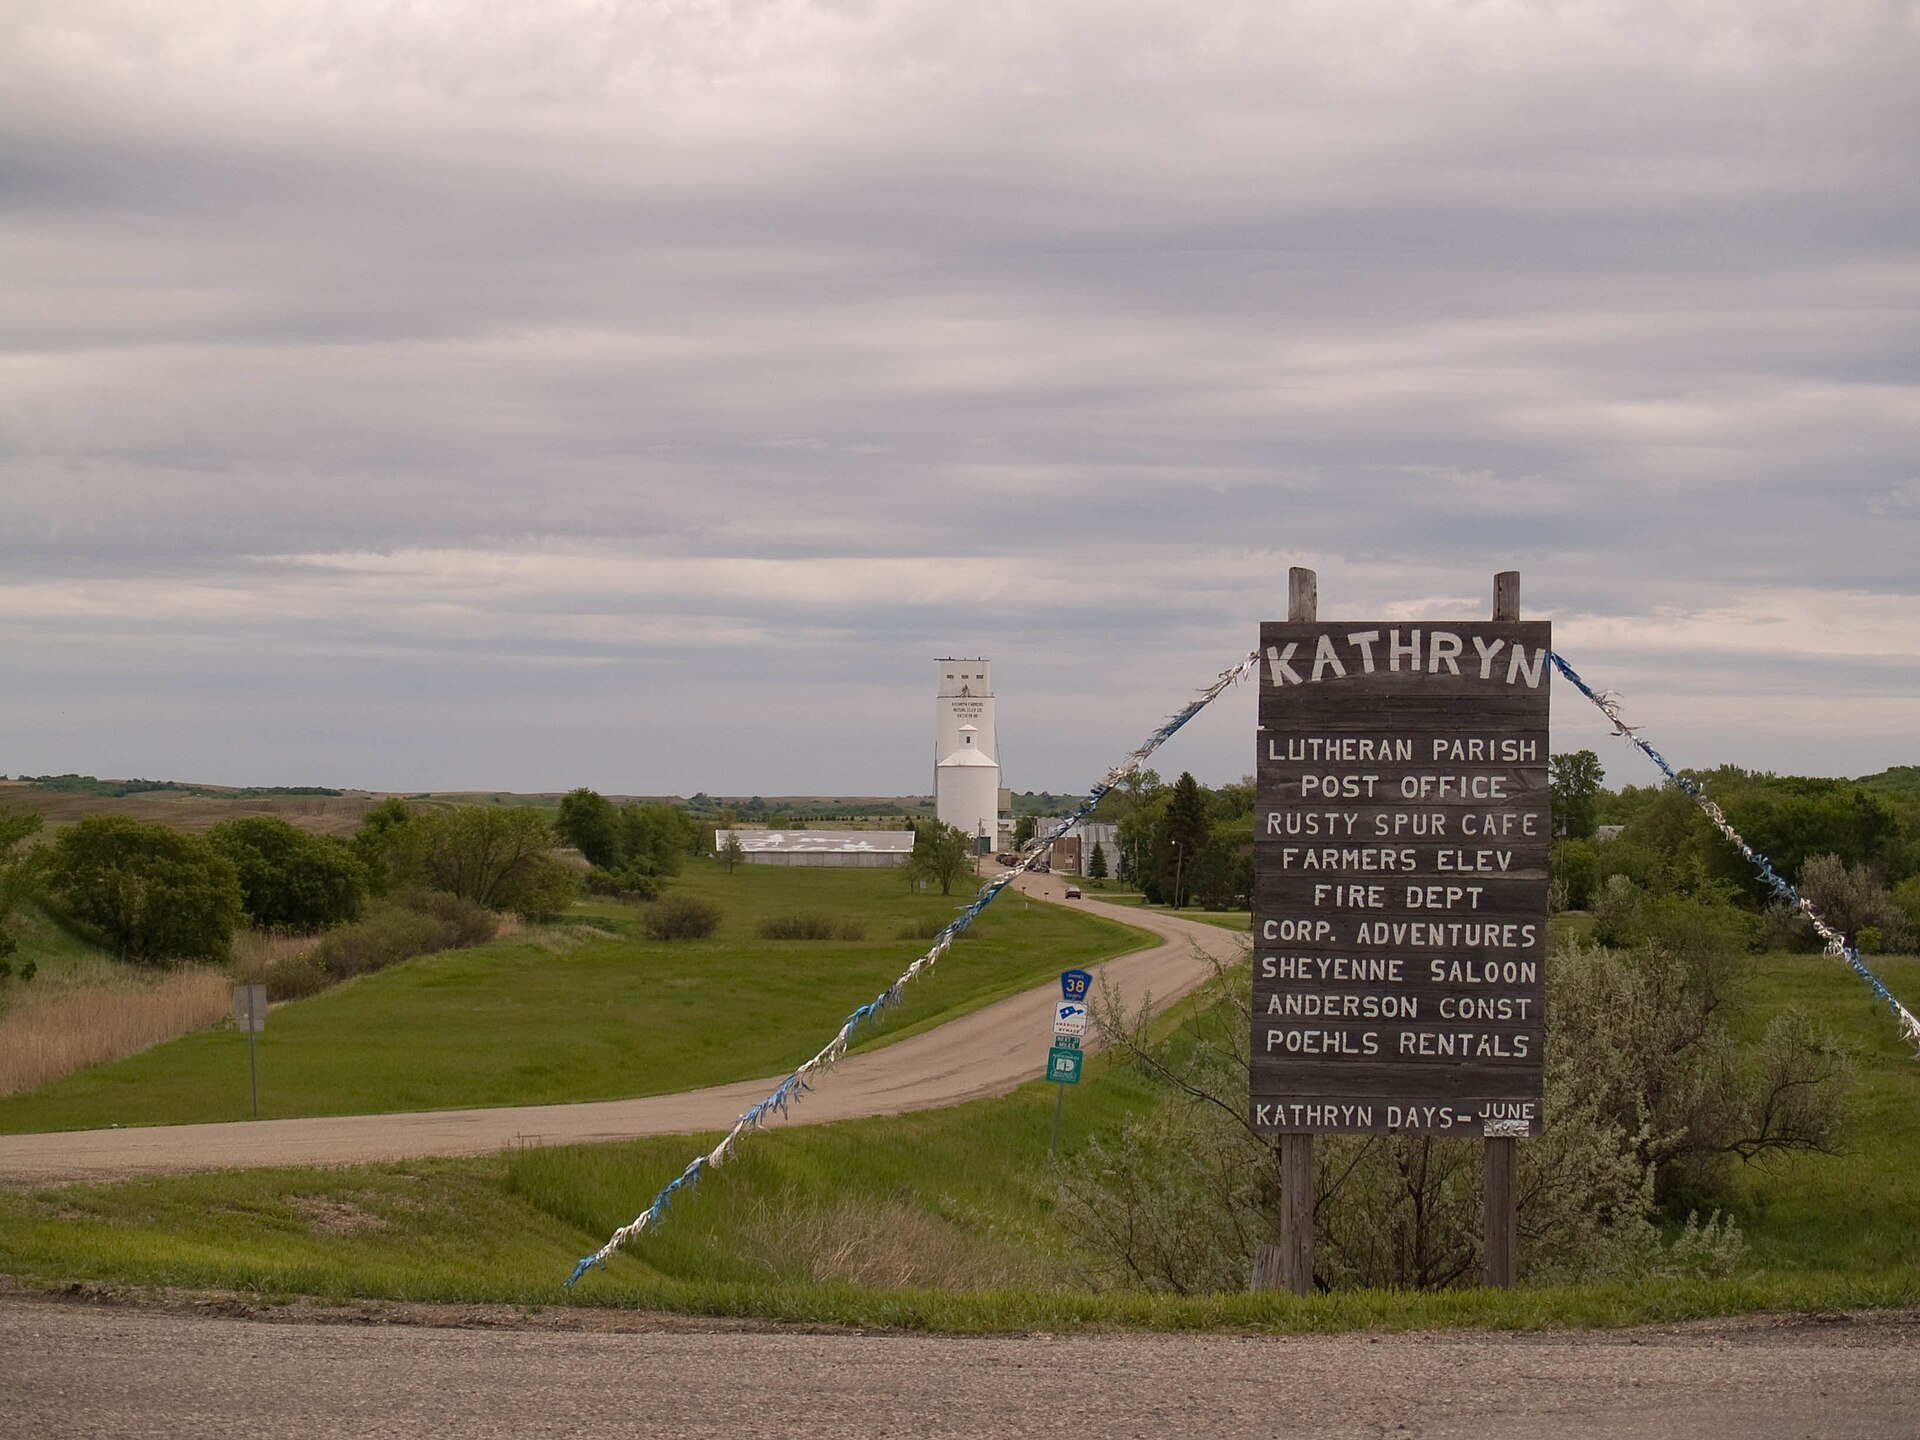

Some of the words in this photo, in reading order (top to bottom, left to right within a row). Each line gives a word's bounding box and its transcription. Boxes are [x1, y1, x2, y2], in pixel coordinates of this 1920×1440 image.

[1267, 629, 1546, 688] KATHRYN
[1269, 739, 1412, 761] LUTHERAN
[1433, 739, 1536, 761] PARISH
[1302, 775, 1379, 797] POST
[1401, 776, 1507, 798] OFFICE
[1267, 812, 1359, 835] RUSTY
[1375, 813, 1446, 835] SPUR
[1462, 813, 1538, 836] CAFE
[1283, 848, 1416, 871] FARMERS
[1437, 850, 1512, 871] ELEV
[1314, 884, 1384, 907] FIRE
[1406, 886, 1483, 908] DEPT
[1263, 920, 1336, 941] CORP.
[1357, 922, 1536, 947] ADVENTURES
[1262, 957, 1403, 981] SHEYENNE
[1431, 960, 1536, 983] SALOON
[1066, 979, 1084, 992] 38
[1267, 994, 1418, 1018] ANDERSON
[1440, 998, 1532, 1020] CONST
[1267, 1030, 1378, 1054] POEHLS
[1400, 1032, 1530, 1057] RENTALS
[1257, 1104, 1372, 1127] KATHRYN
[1478, 1103, 1535, 1119] JUNE
